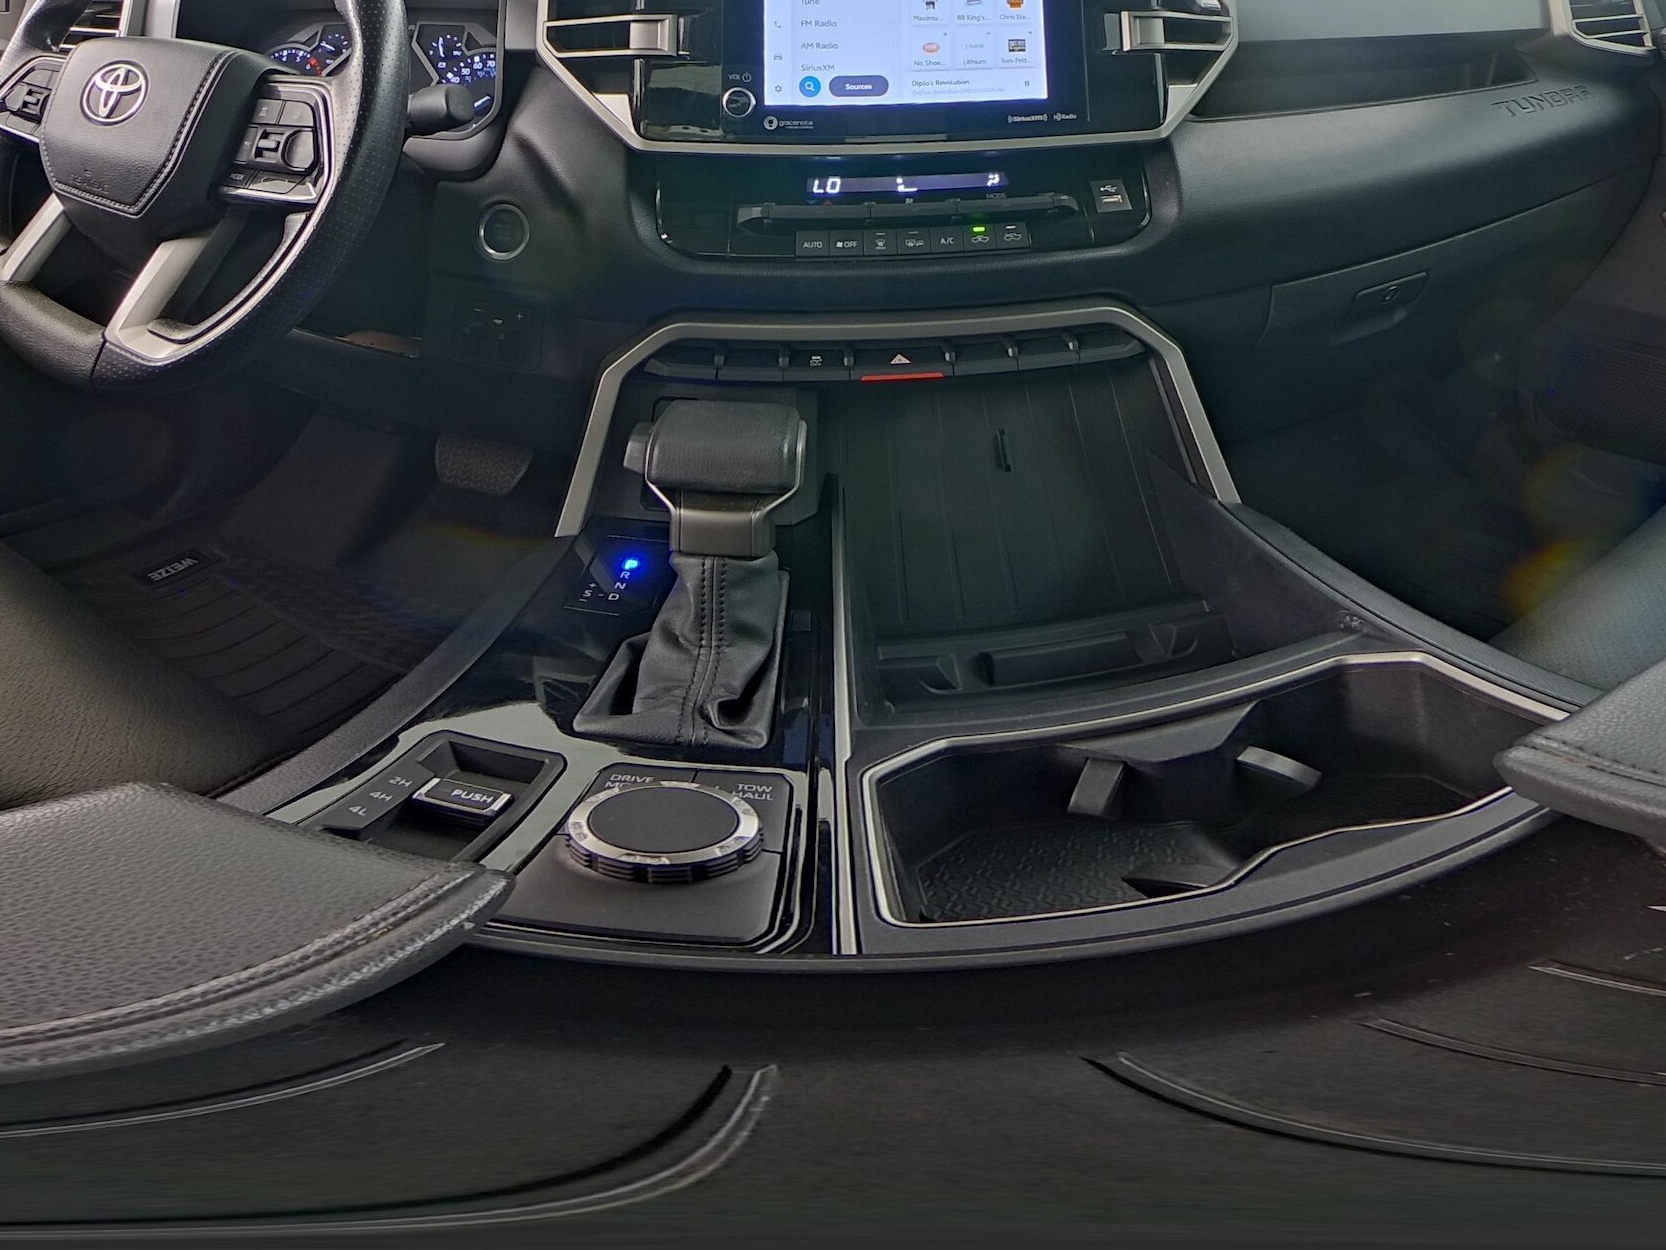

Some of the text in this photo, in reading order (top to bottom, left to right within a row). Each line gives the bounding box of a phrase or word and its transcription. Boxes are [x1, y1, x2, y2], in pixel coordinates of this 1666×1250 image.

[801, 20, 837, 28] FM Radio
[816, 42, 839, 50] Radio
[473, 62, 483, 70] 60
[801, 64, 835, 72] SiriusXM
[461, 68, 470, 76] 50
[845, 83, 873, 91] Sources
[1490, 85, 1595, 118] TUNDRA
[812, 176, 842, 194] LO
[803, 241, 823, 249] AUTO
[844, 240, 858, 248] OFF
[940, 237, 955, 245] A/C
[147, 557, 199, 581] WEIZE
[624, 559, 639, 570] P
[619, 570, 631, 579] R
[614, 581, 627, 590] N
[582, 589, 593, 597] S
[389, 776, 413, 788] 2H
[610, 773, 655, 783] DRIVE
[736, 783, 773, 793] TOW
[369, 791, 393, 802] 4H
[451, 788, 494, 804] PUSH
[732, 791, 774, 801] HAUL
[348, 805, 368, 816] 4L
